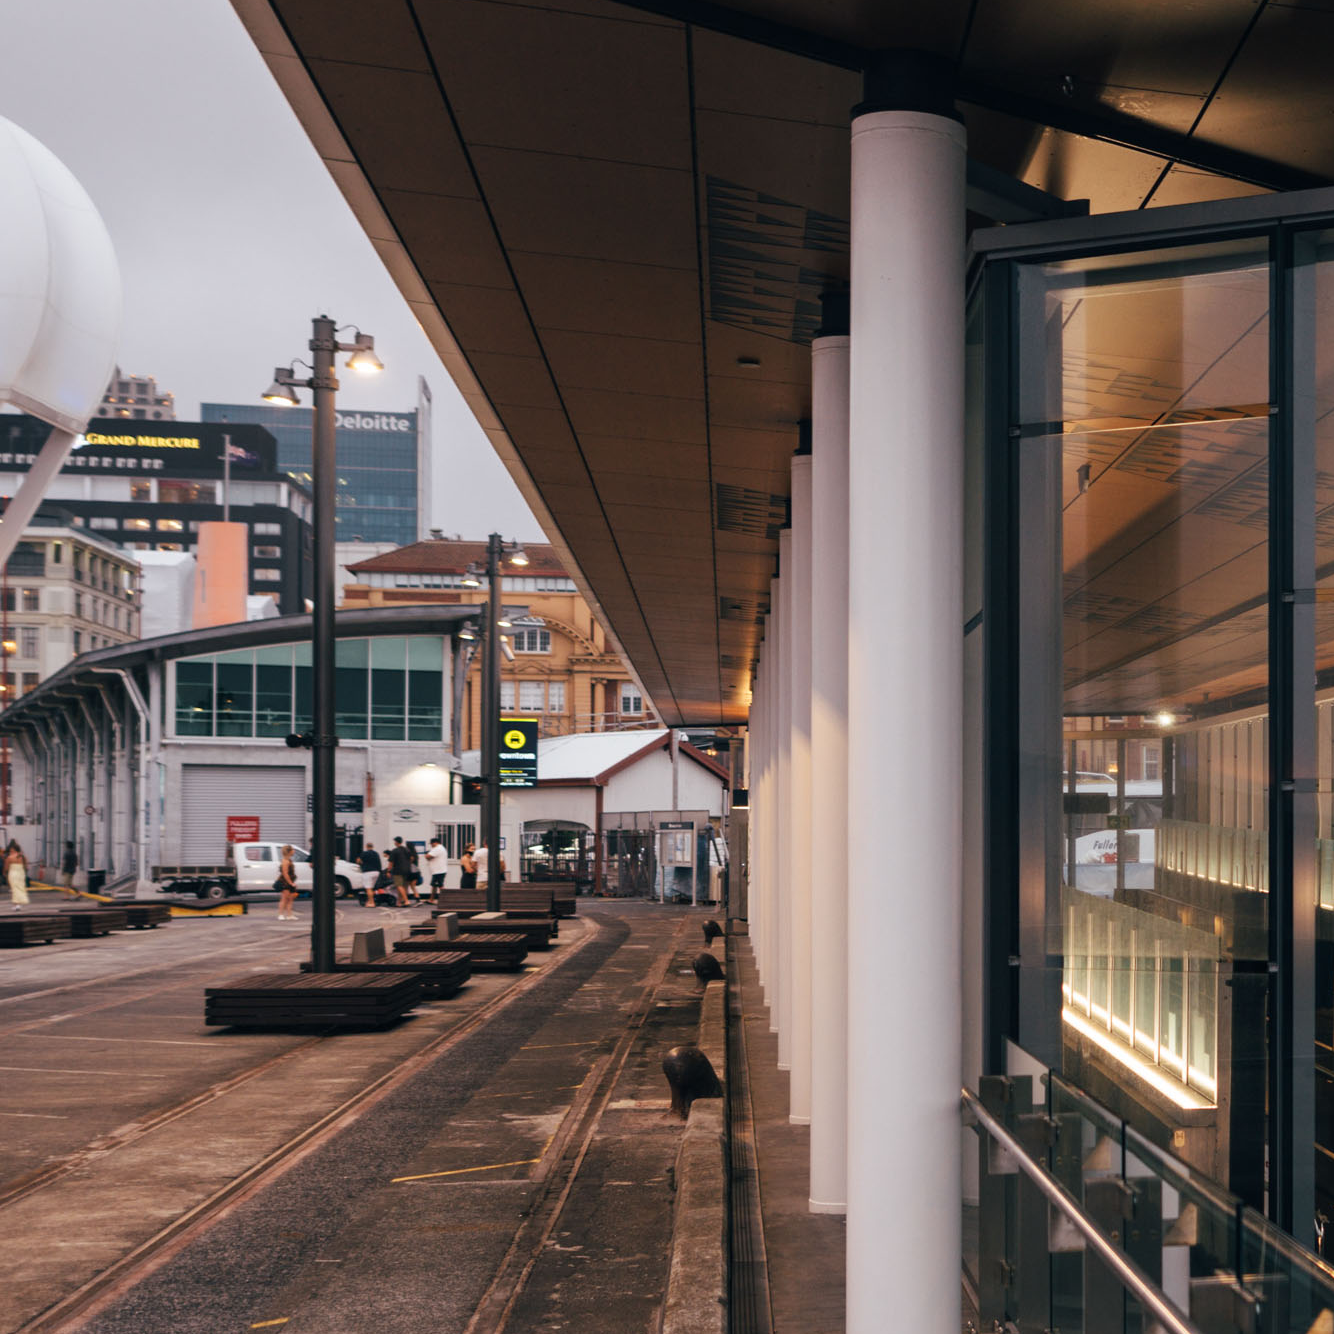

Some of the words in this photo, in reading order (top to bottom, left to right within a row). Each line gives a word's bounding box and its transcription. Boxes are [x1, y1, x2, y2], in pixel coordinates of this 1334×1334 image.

[335, 412, 410, 431] Deloitte
[86, 433, 137, 446] GRAND
[137, 435, 200, 448] MERCURE
[499, 752, 537, 760] owntown
